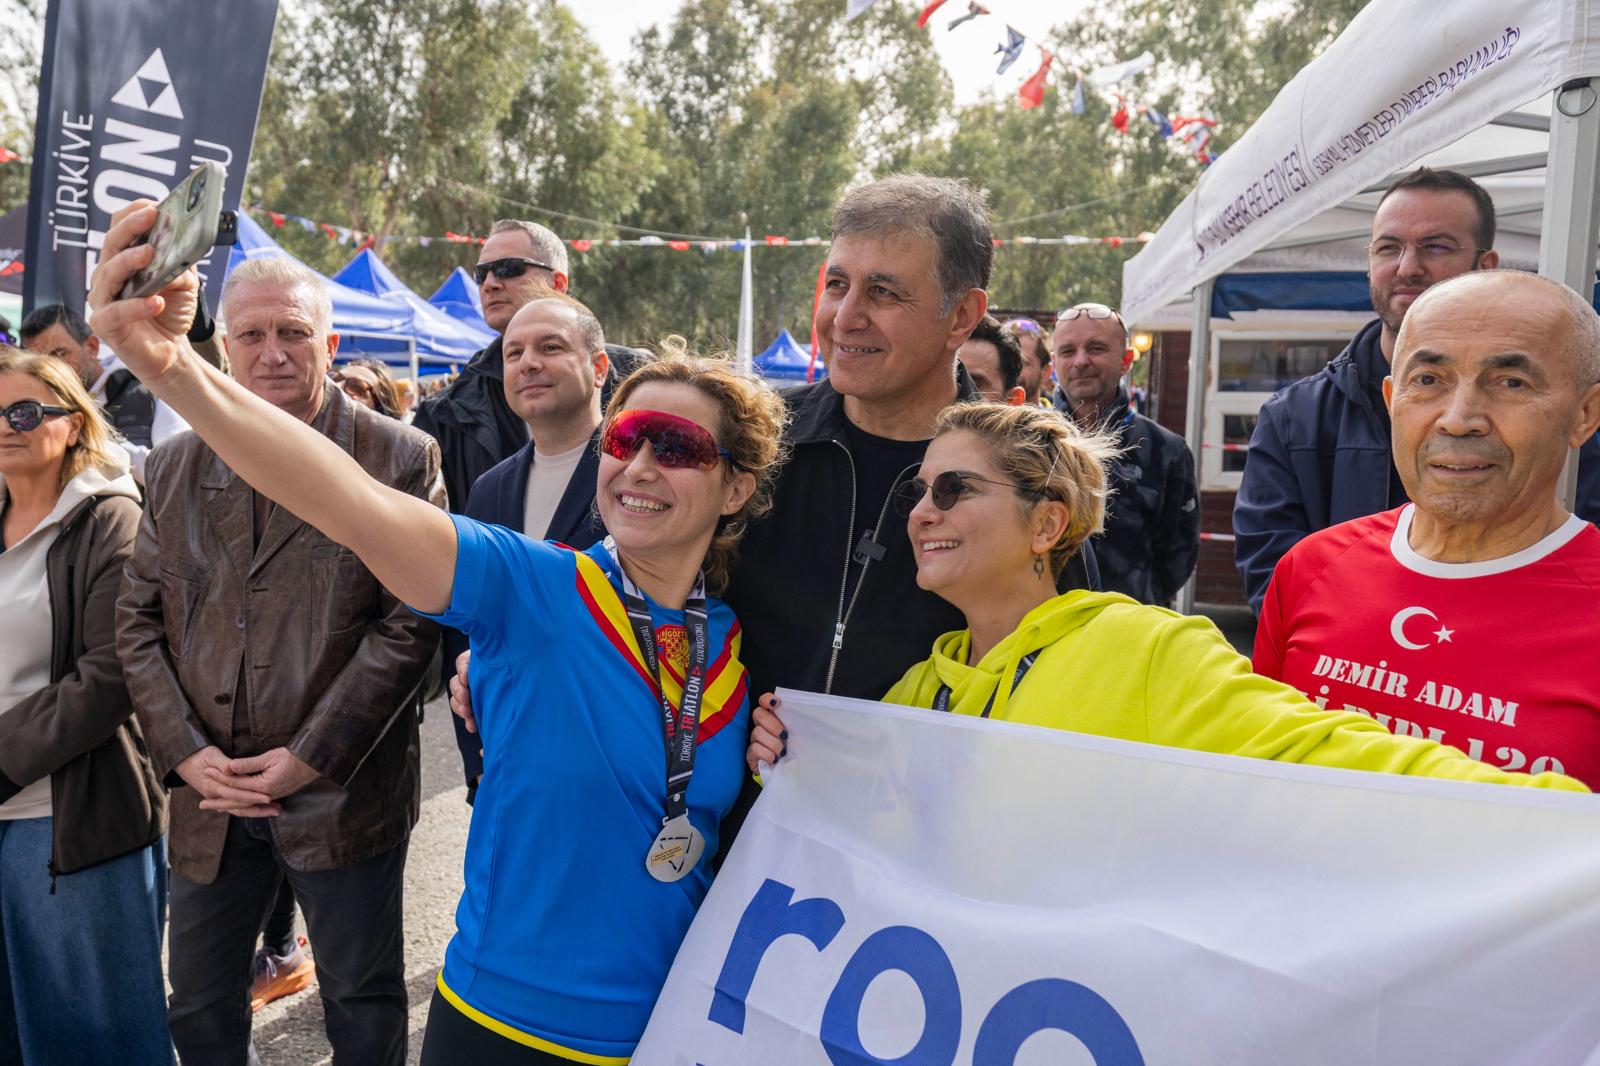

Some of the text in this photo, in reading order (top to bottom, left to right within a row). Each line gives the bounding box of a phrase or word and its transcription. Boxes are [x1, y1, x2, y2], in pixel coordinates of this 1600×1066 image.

[48, 110, 94, 252] TÜRKİYE
[1312, 655, 1409, 698] DEMİR
[1414, 680, 1520, 728] ADAM
